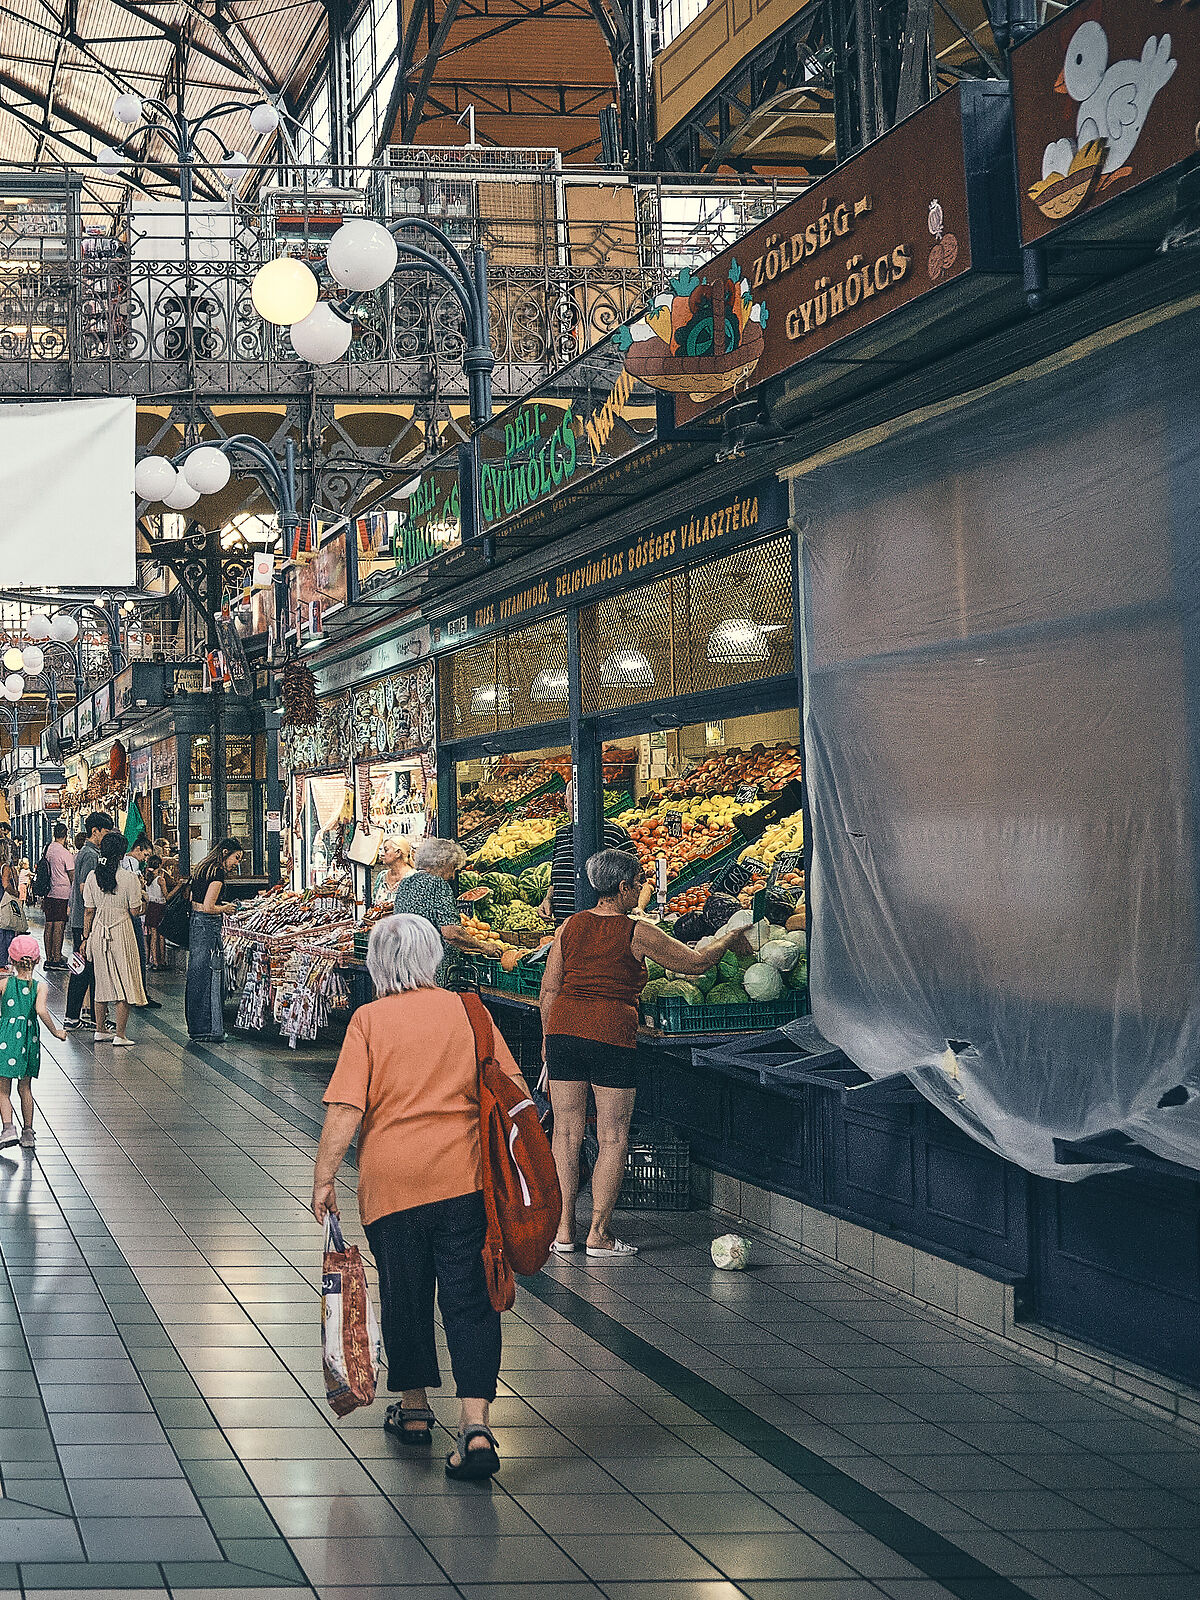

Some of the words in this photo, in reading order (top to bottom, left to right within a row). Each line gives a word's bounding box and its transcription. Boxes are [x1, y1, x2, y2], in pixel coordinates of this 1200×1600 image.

[752, 195, 872, 289] ZÖLDSÉG-
[481, 405, 576, 522] GYÜMÖLCS
[505, 404, 547, 458] DÉLI-
[681, 495, 758, 550] VÁLASZTÉKA
